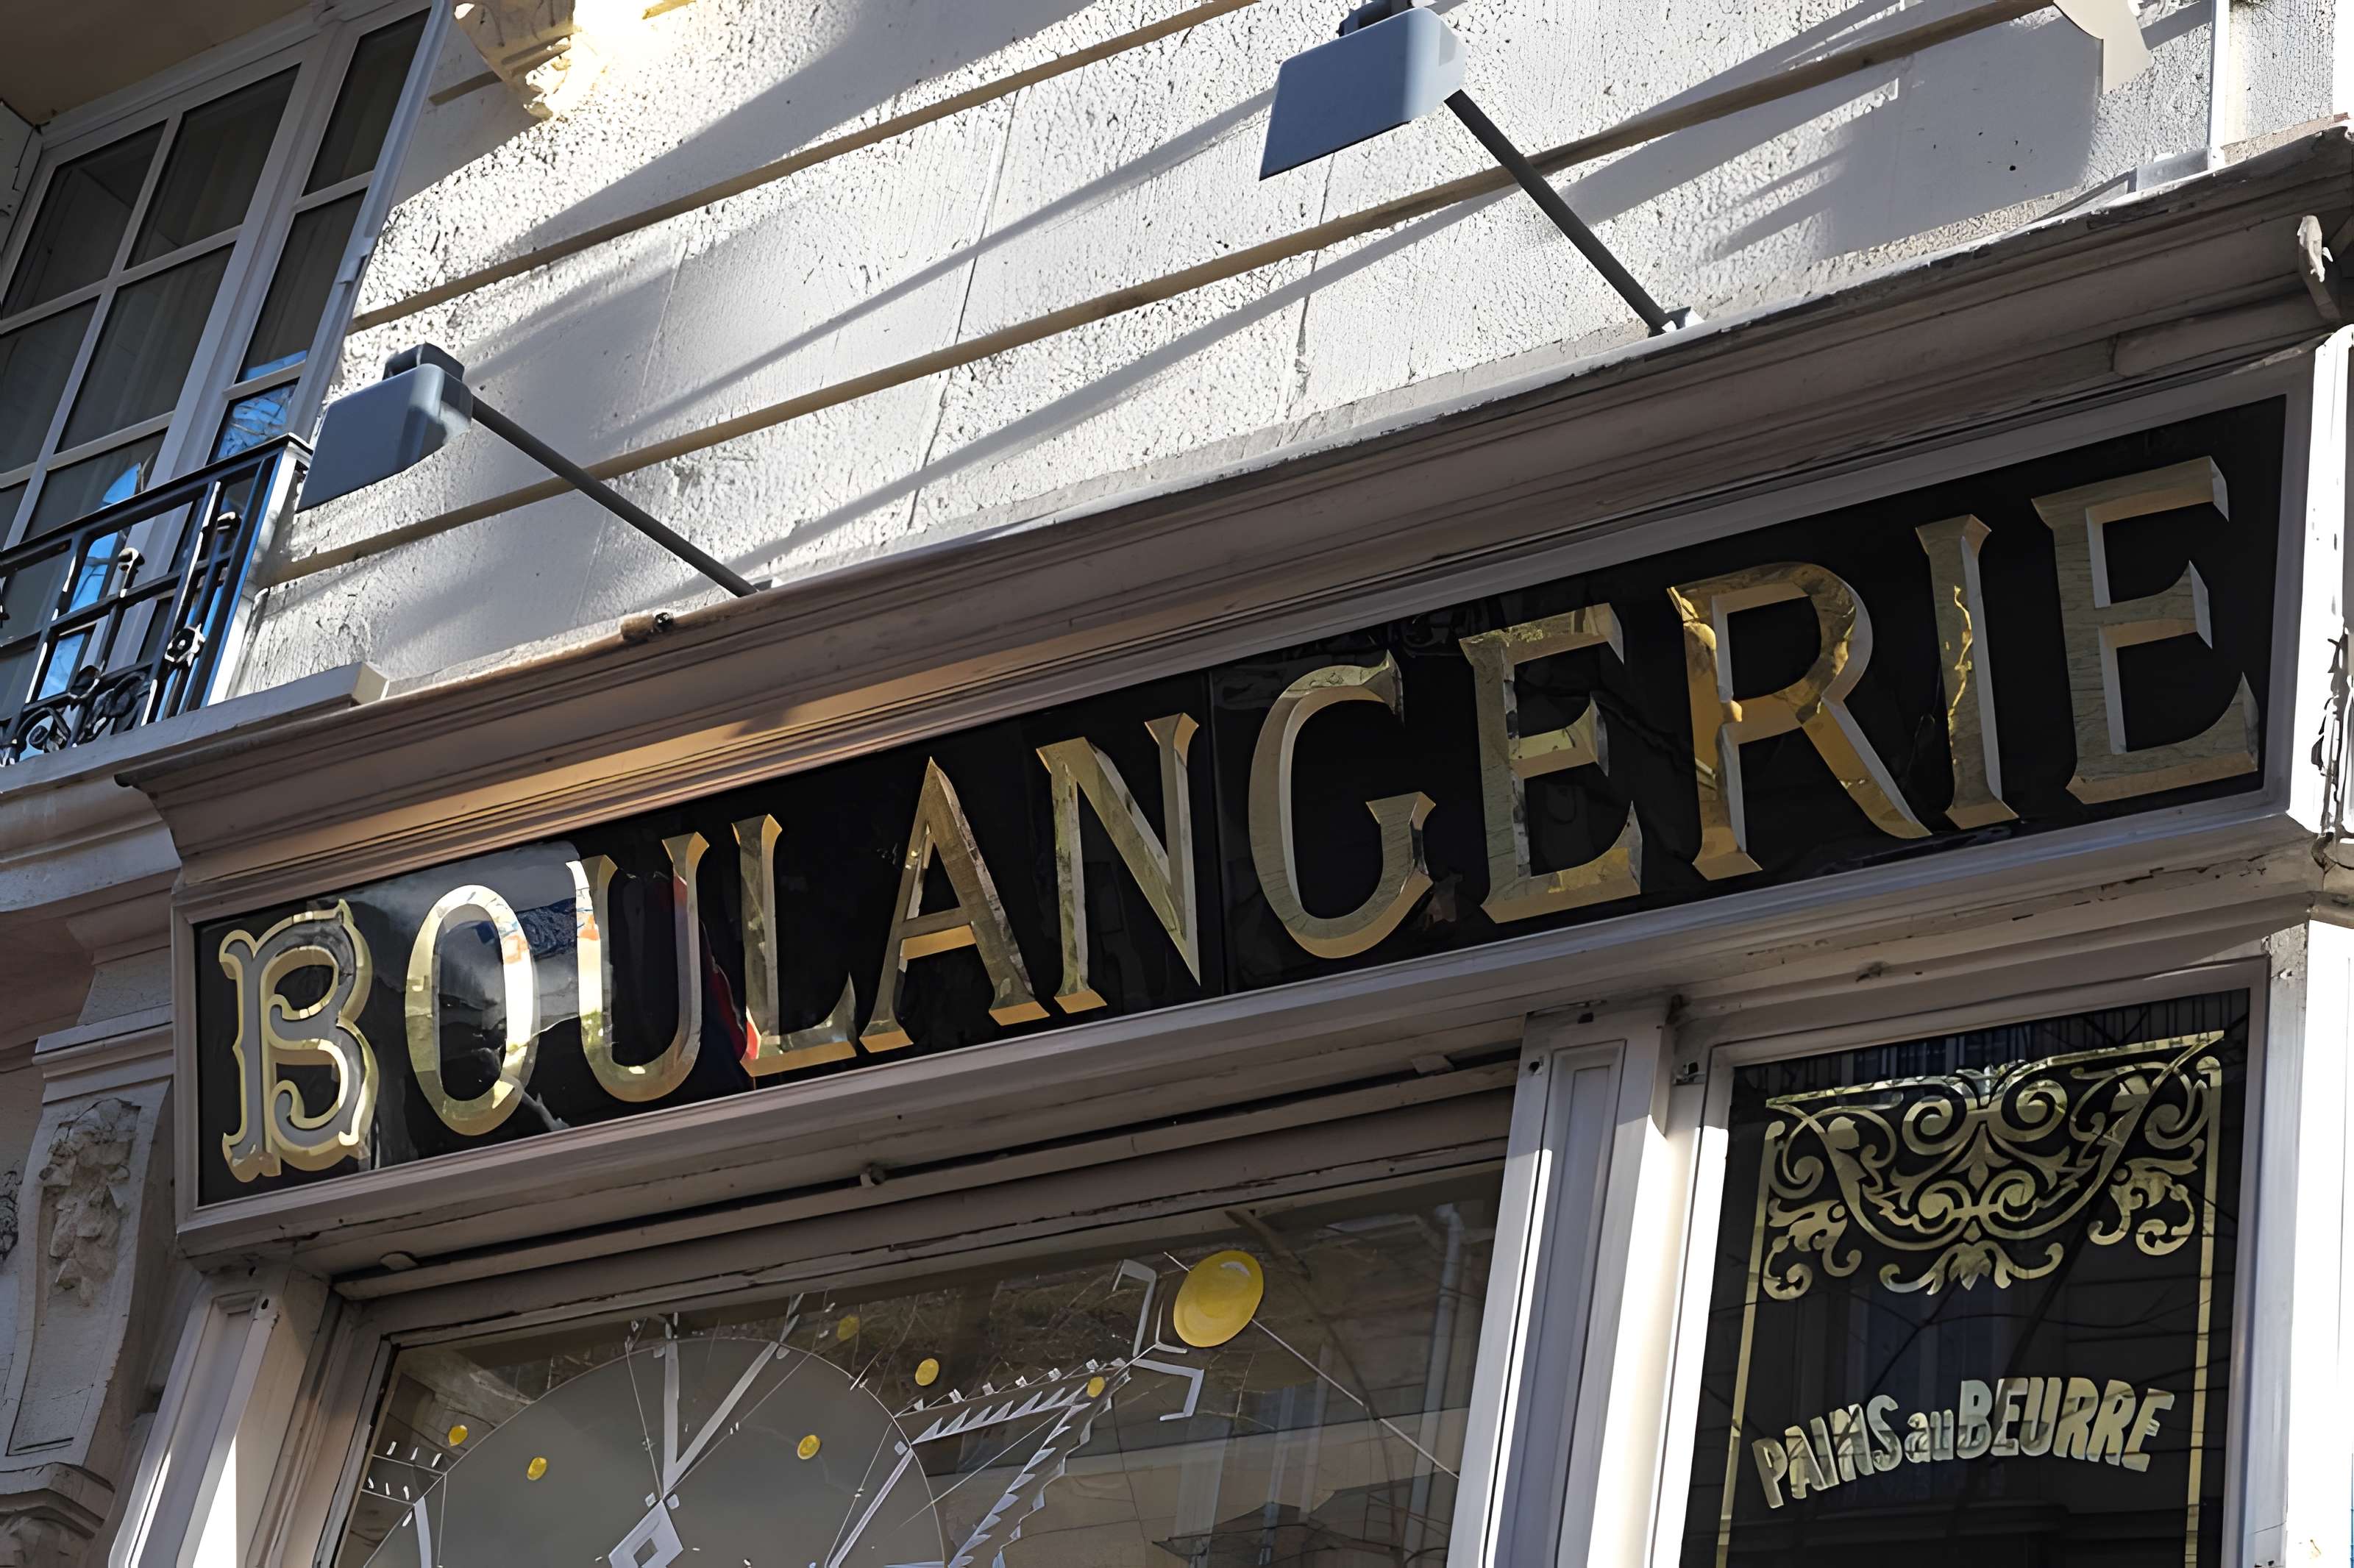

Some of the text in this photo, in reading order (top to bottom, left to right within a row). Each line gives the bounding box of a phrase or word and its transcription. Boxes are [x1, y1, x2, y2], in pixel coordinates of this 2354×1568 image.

[218, 455, 2259, 1183] BOULANGERIE
[1752, 1377, 2175, 1508] PAINS au BEURRE
